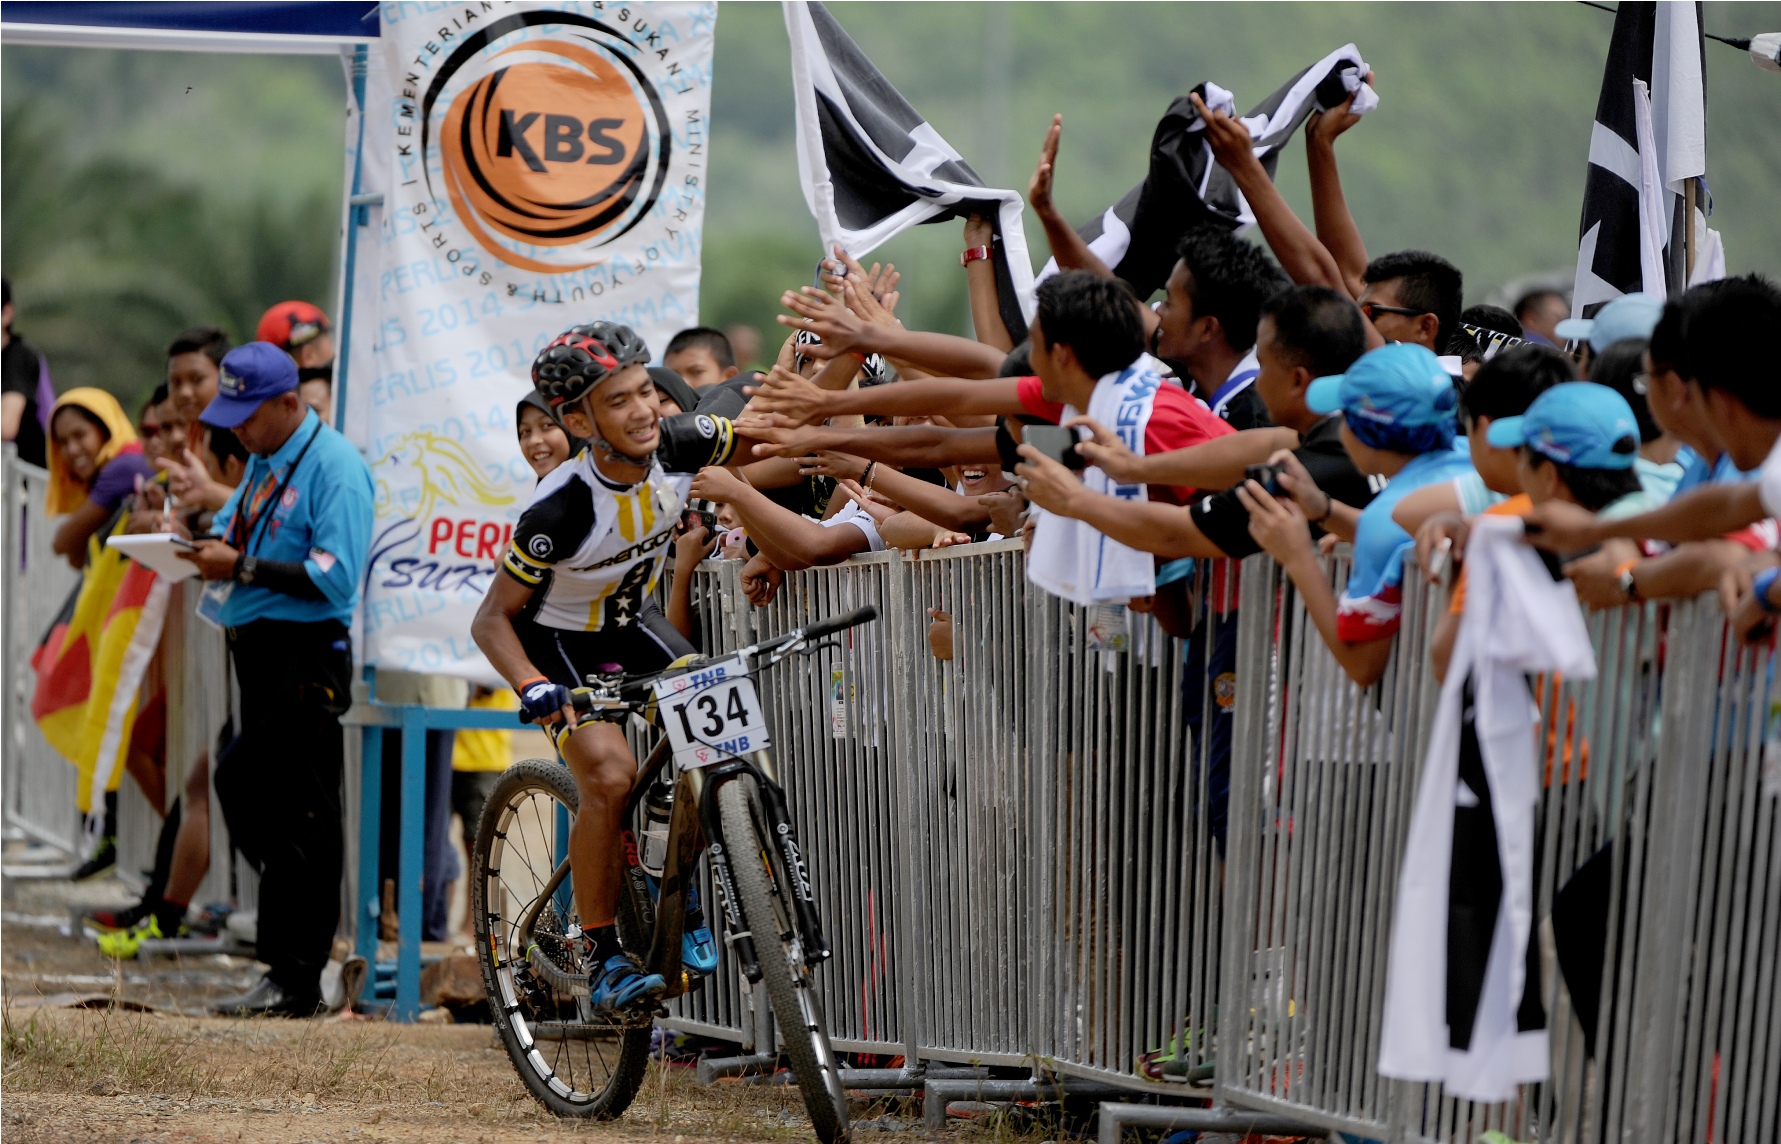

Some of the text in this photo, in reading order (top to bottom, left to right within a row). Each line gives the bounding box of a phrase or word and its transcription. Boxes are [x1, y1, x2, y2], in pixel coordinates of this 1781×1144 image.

[617, 8, 682, 77] SUKAN
[398, 1, 493, 157] KEMENTERIAN
[496, 108, 627, 173] KBS
[664, 109, 703, 241] MINISTRY
[412, 202, 493, 286] SPORTS
[634, 247, 660, 276] OF
[416, 289, 504, 338] 2014
[533, 273, 624, 304] YOUTH
[382, 557, 497, 595] SUK
[690, 667, 727, 690] TNB
[672, 686, 749, 744] 134
[713, 736, 750, 759] TNB
